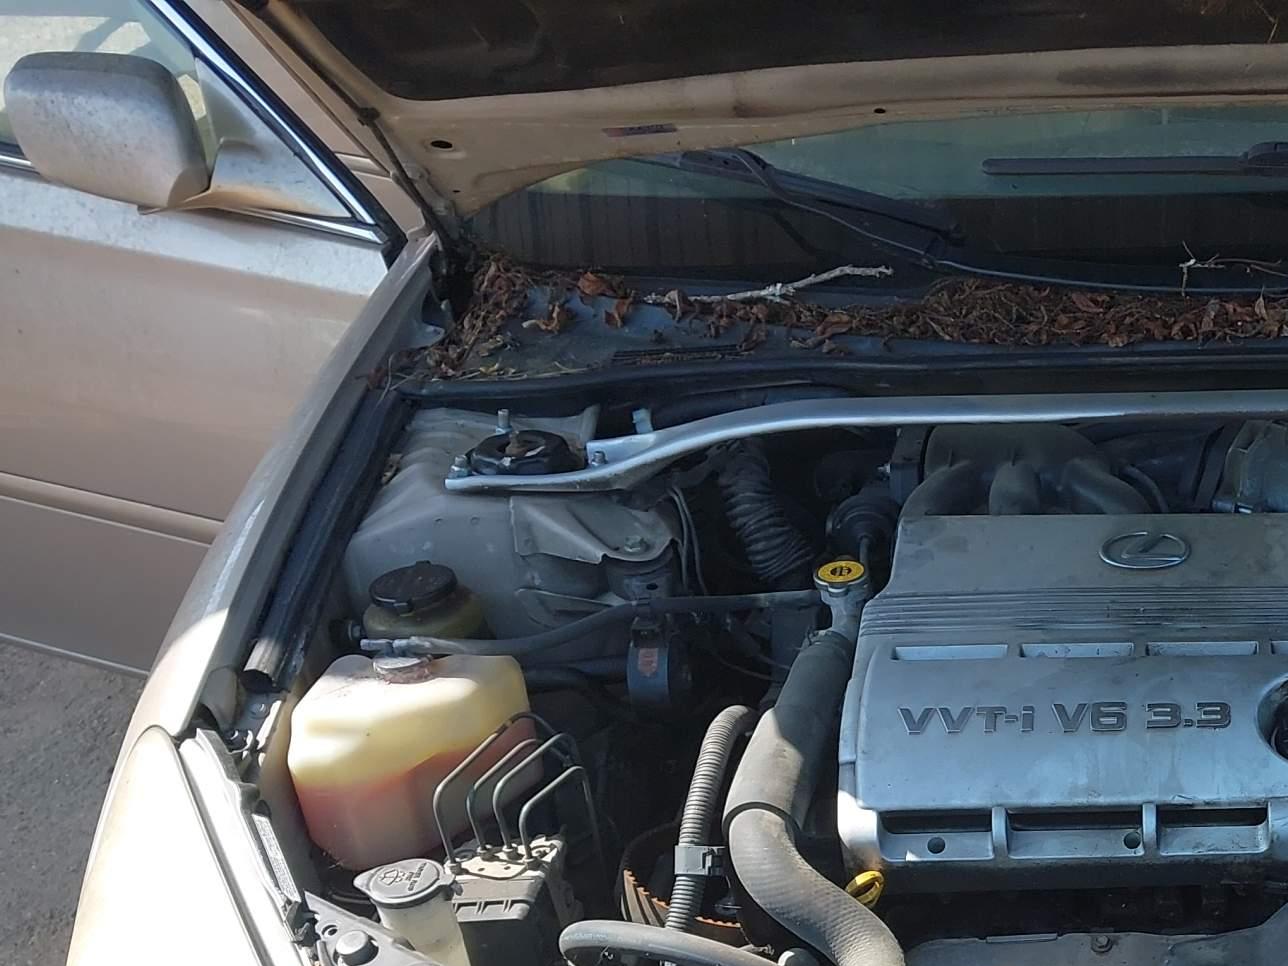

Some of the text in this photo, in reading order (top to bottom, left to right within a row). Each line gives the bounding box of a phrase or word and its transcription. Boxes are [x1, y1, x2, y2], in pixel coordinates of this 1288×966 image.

[897, 702, 1232, 735] VVT-i V6 3.3
